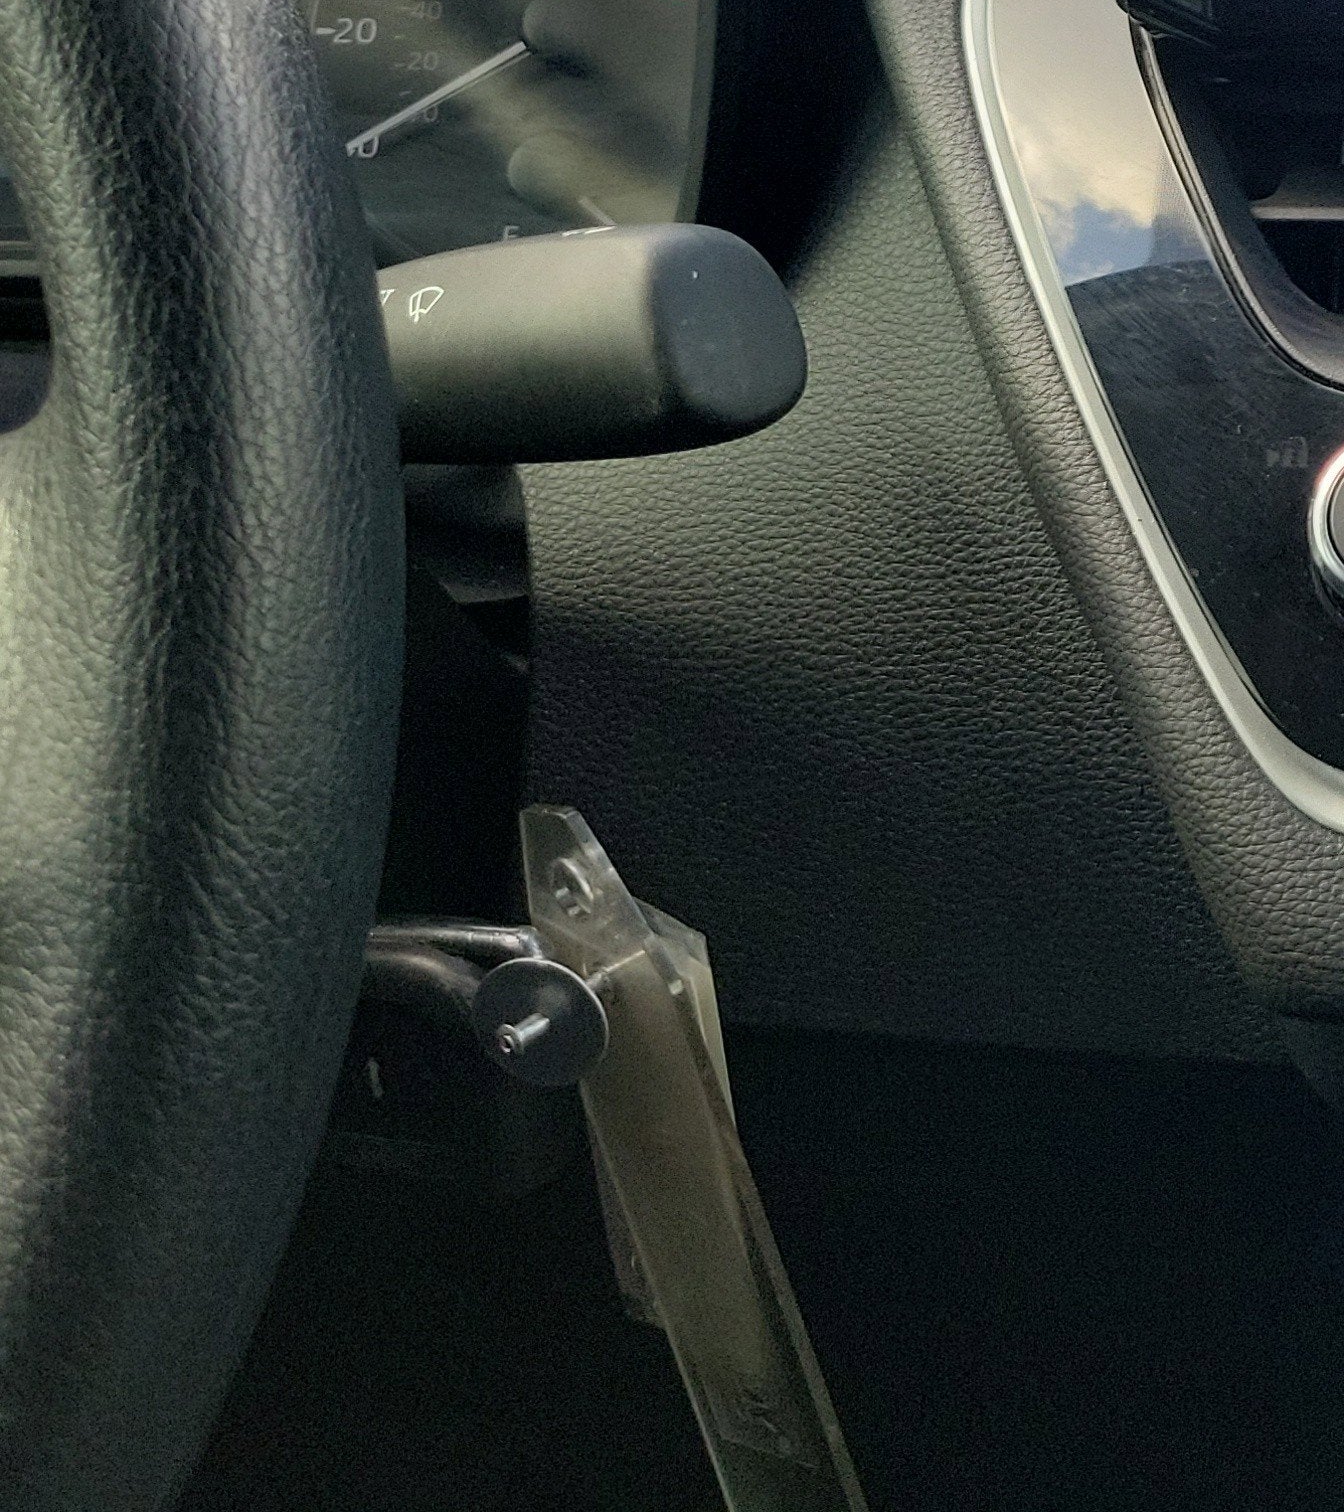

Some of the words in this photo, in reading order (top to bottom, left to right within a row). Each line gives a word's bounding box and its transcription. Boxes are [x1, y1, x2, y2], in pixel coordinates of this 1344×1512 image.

[410, 1, 443, 21] 40
[332, 17, 378, 44] 20
[407, 51, 440, 72] 20
